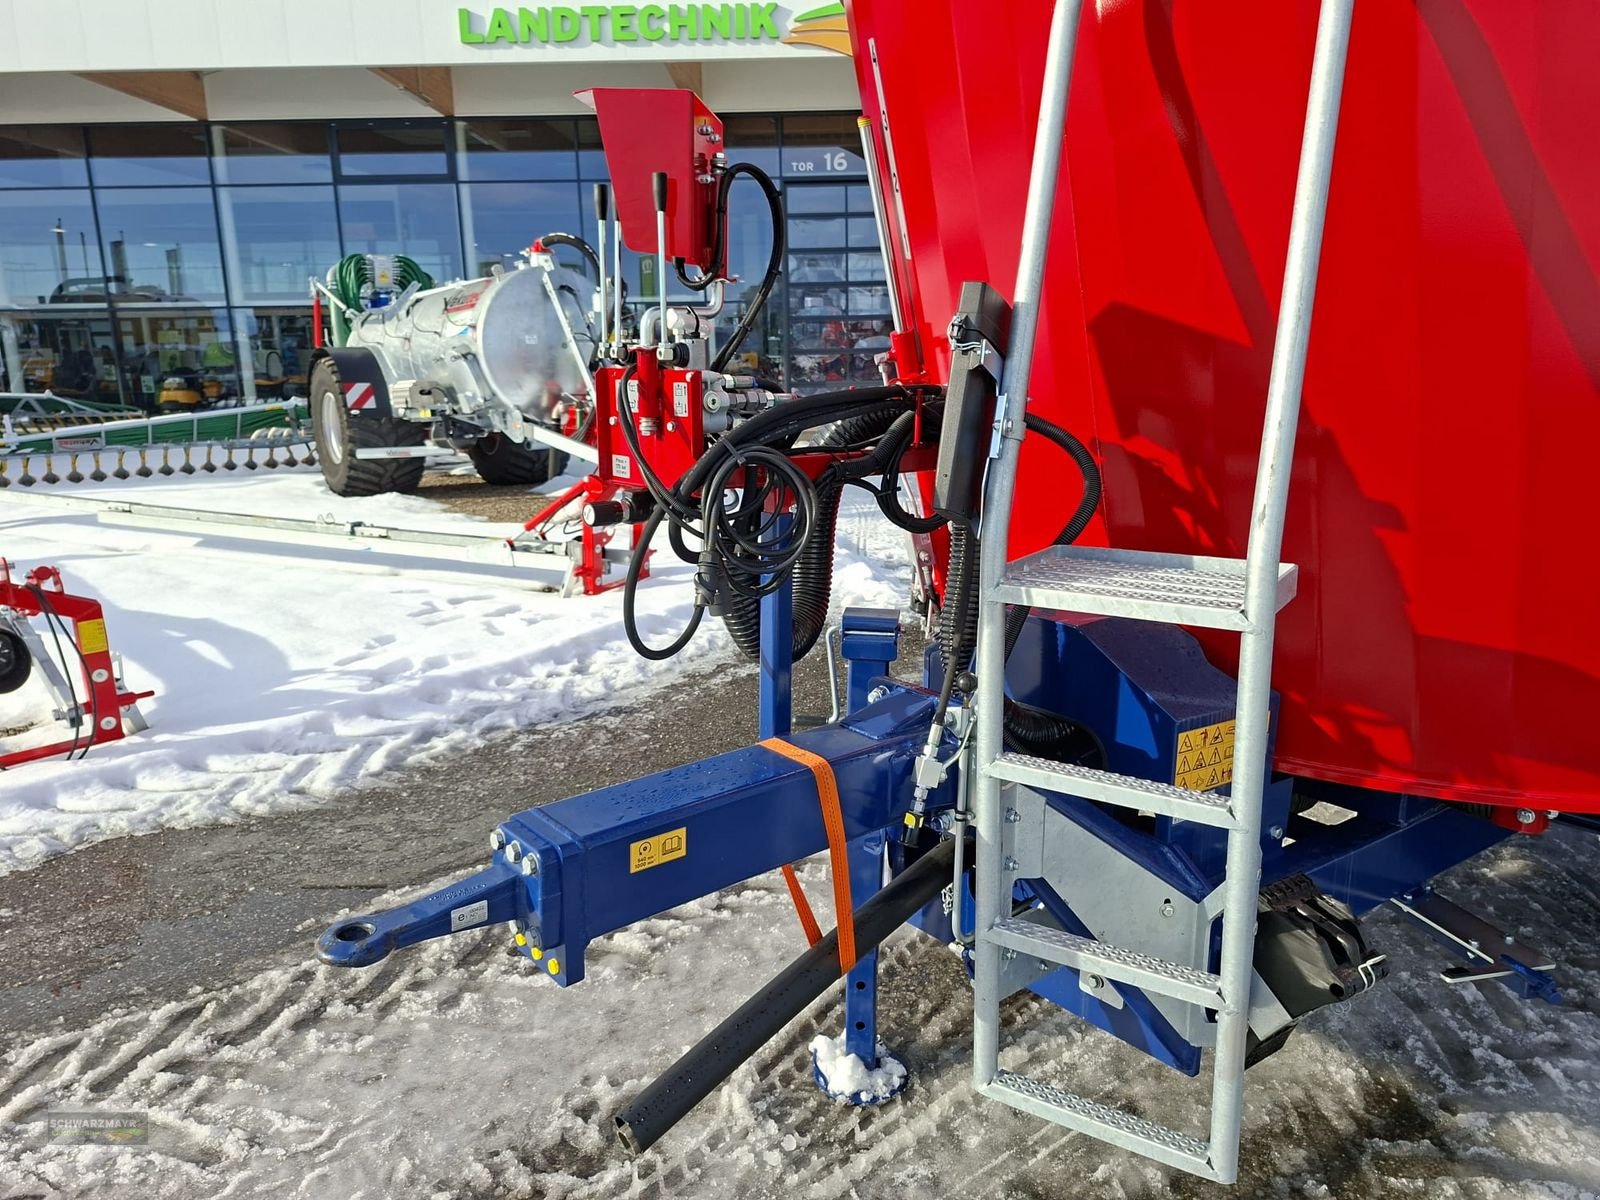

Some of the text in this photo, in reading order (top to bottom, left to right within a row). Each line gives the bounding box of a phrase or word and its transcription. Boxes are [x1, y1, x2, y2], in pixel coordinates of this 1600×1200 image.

[458, 2, 780, 45] LANDTECHNIK
[791, 152, 848, 171] TOR 16
